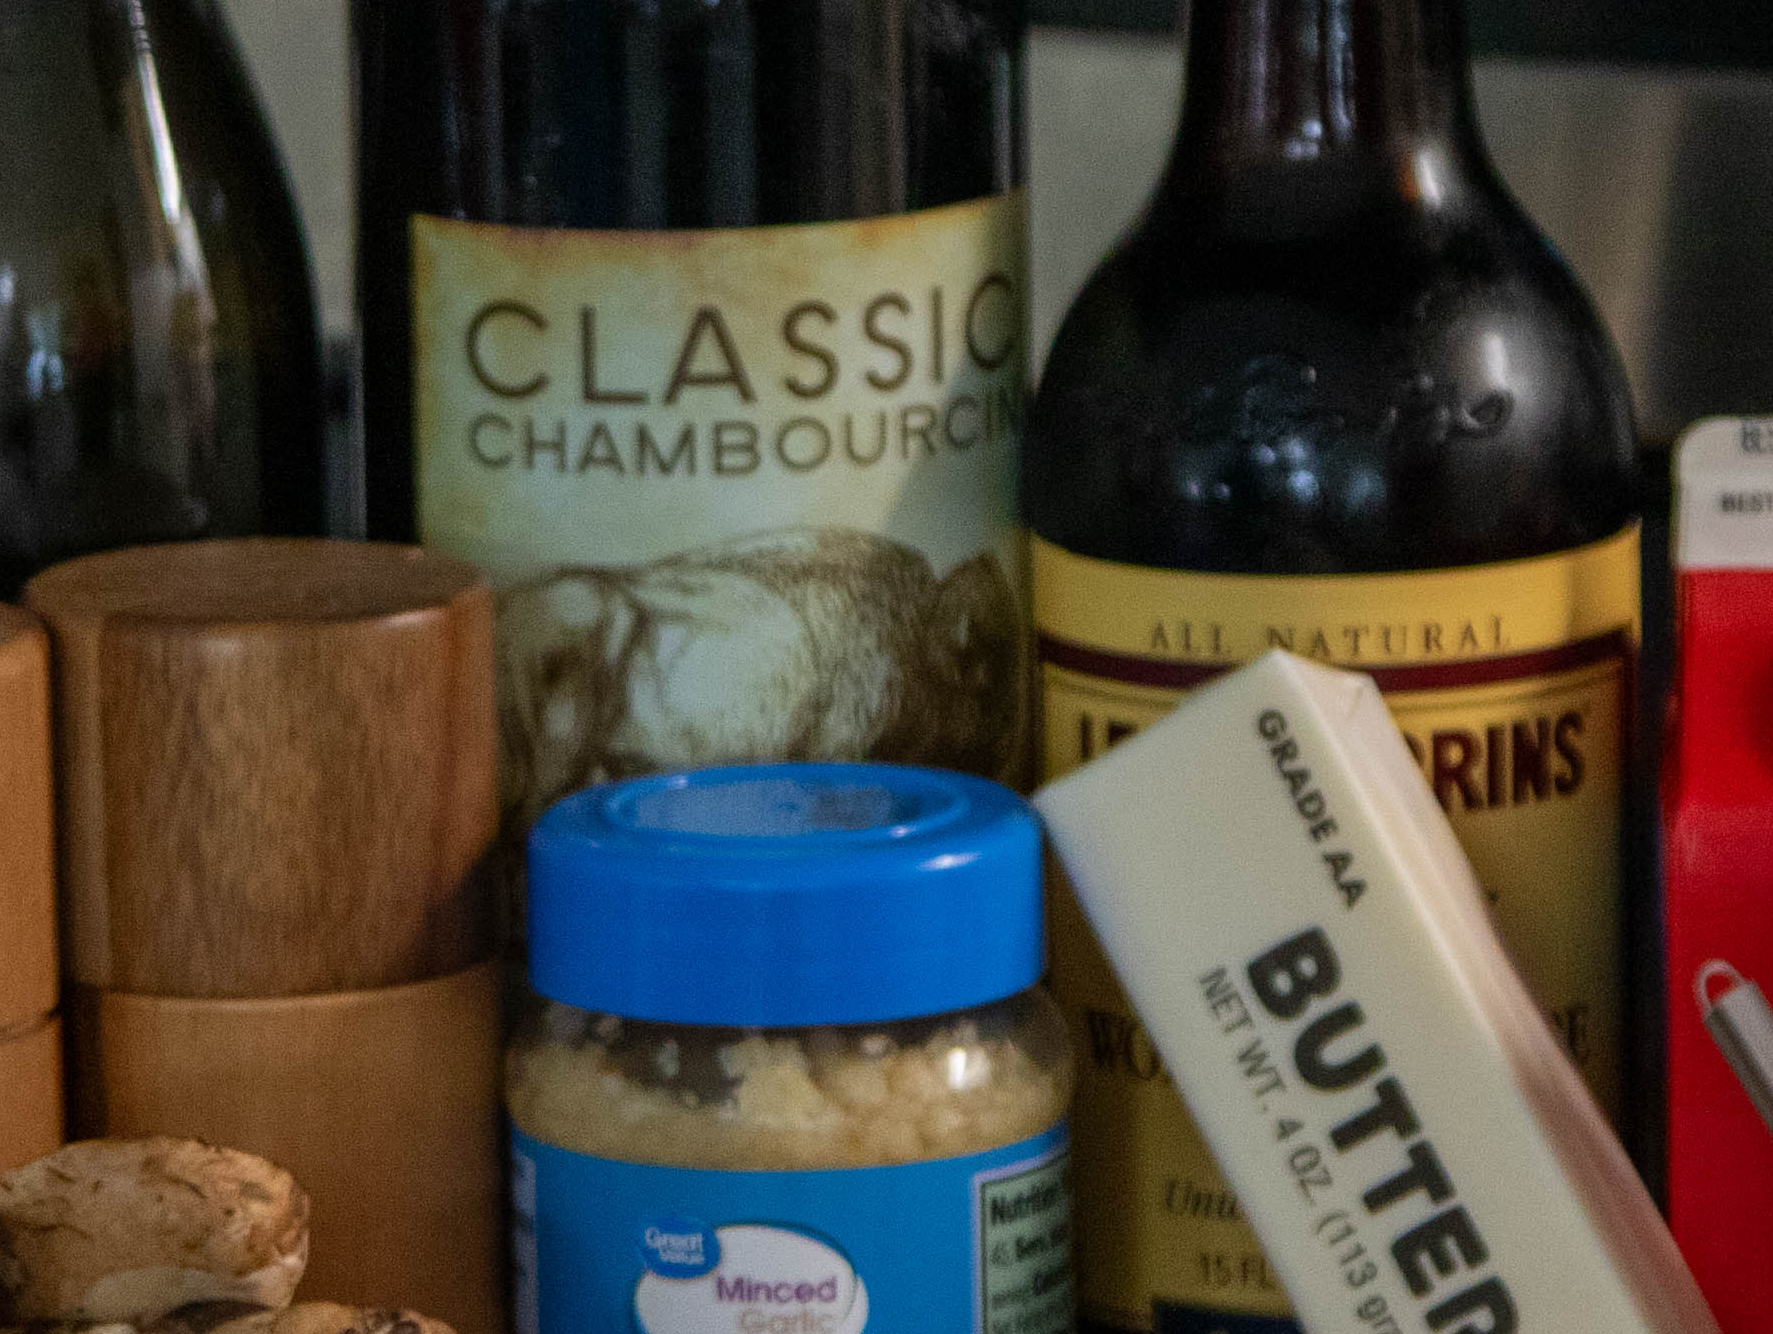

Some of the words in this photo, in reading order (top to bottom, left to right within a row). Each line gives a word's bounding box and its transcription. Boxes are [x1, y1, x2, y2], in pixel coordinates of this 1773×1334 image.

[466, 271, 1016, 407] CLASSIC
[1150, 620, 1223, 655] ALL
[1265, 615, 1513, 657] NATURAL
[1432, 710, 1589, 813] RINS
[1257, 708, 1339, 844] GRADE
[1322, 851, 1368, 912] AA
[1198, 964, 1256, 1036] NET
[1236, 1038, 1288, 1112] WT.
[1275, 1117, 1305, 1143] 4
[1289, 1144, 1334, 1208] OZ.
[1315, 1210, 1379, 1290] (113
[716, 1275, 838, 1305] Minced
